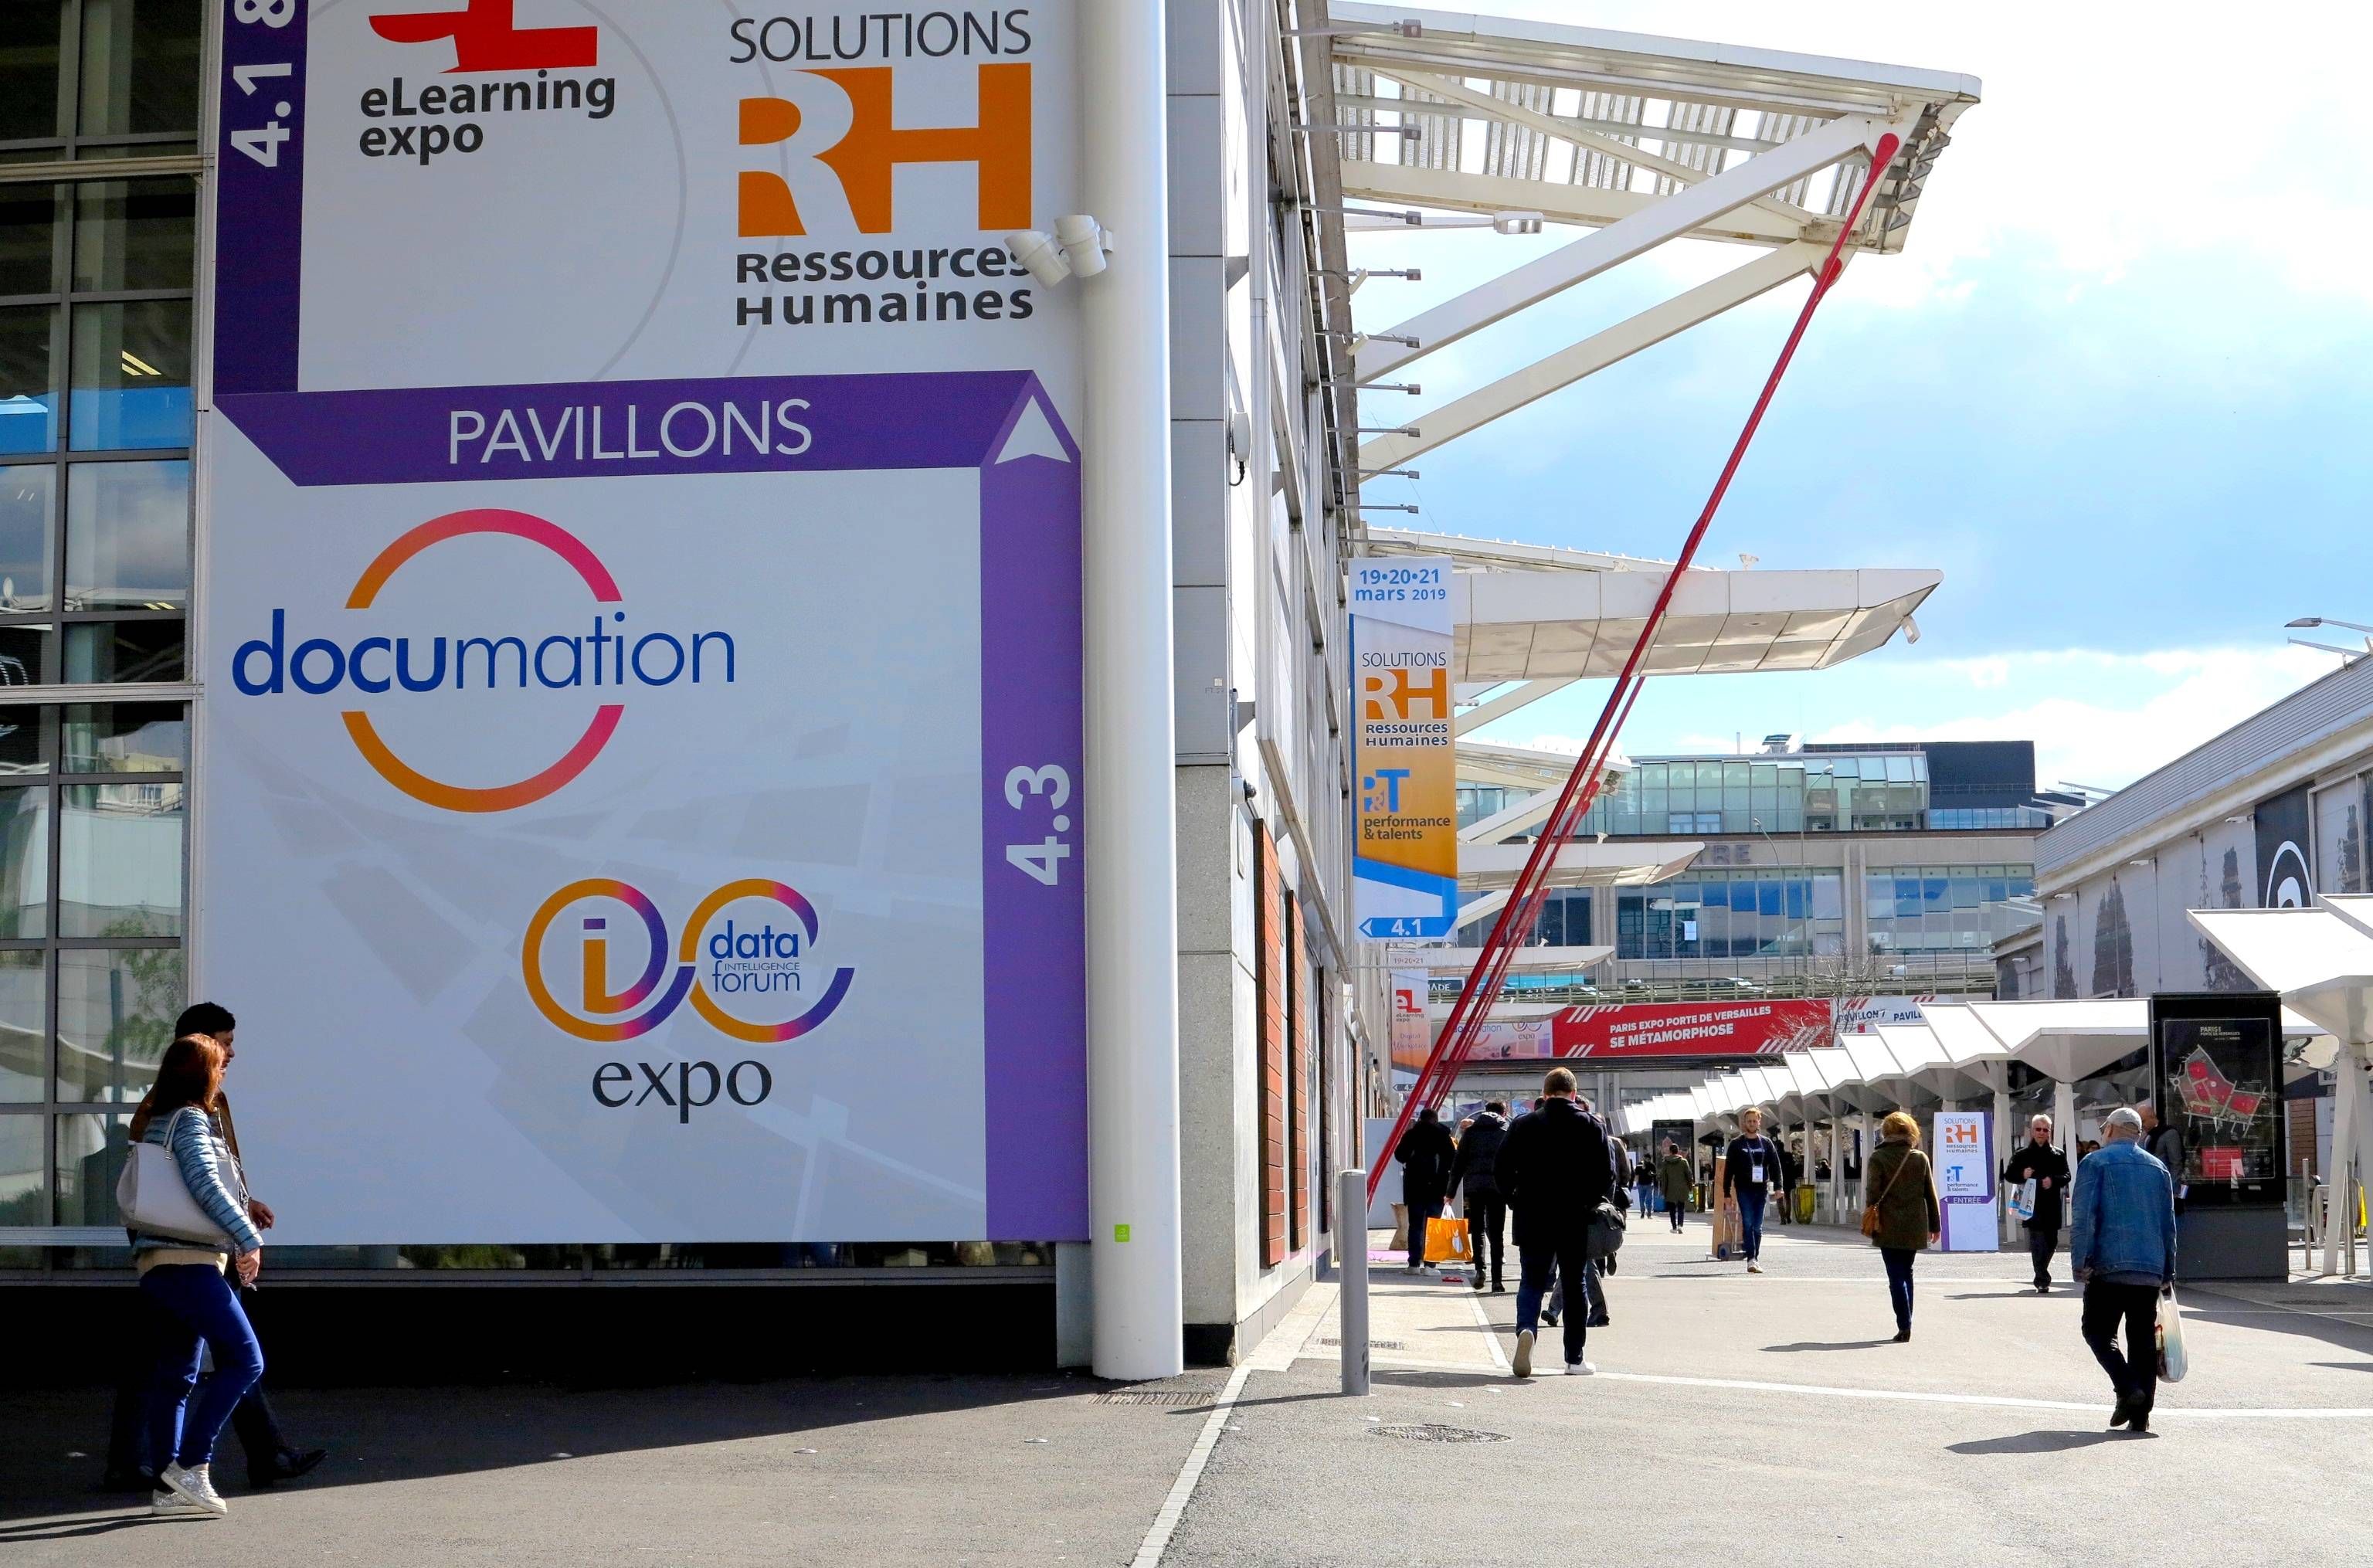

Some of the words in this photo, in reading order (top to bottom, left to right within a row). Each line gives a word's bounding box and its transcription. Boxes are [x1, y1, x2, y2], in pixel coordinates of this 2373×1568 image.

[729, 8, 1032, 63] SOLUTIONS
[360, 69, 615, 119] eLearning
[230, 63, 292, 168] 4.1
[359, 123, 484, 166] expo
[736, 62, 1032, 237] RH
[736, 246, 1031, 283] Ressources
[736, 280, 1034, 326] Humaines
[450, 399, 812, 464] PAVILLONS
[1355, 588, 1406, 602] mars
[1412, 589, 1446, 600] 2019
[232, 609, 735, 697] documation
[1362, 652, 1447, 667] SOLUTIONS
[1365, 668, 1448, 720] RH
[1365, 723, 1448, 734] Ressources
[1366, 735, 1448, 747] Humaines
[1005, 764, 1071, 887] 4.3
[1363, 815, 1451, 829] performance
[1364, 827, 1374, 840] &
[1377, 828, 1423, 840] talents
[709, 919, 799, 959] data
[1390, 918, 1422, 936] 4.1
[712, 959, 800, 993] forum
[725, 962, 800, 972] INTELLIGENCE
[1610, 1023, 1637, 1033] PARIS
[1639, 1019, 1664, 1030] EXPO
[1666, 1015, 1698, 1027] PORTE
[1699, 1013, 1712, 1023] DE
[1714, 1006, 1772, 1021] VERSAILLES
[1893, 1010, 1922, 1021] PAVILL
[1518, 1033, 1536, 1041] expo
[1610, 1036, 1625, 1048] SE
[1628, 1023, 1734, 1046] MÉTAMORPHOSE
[592, 1060, 772, 1124] expo
[1946, 1125, 1977, 1143] RH
[1954, 1196, 1981, 1204] ENTRÉE
